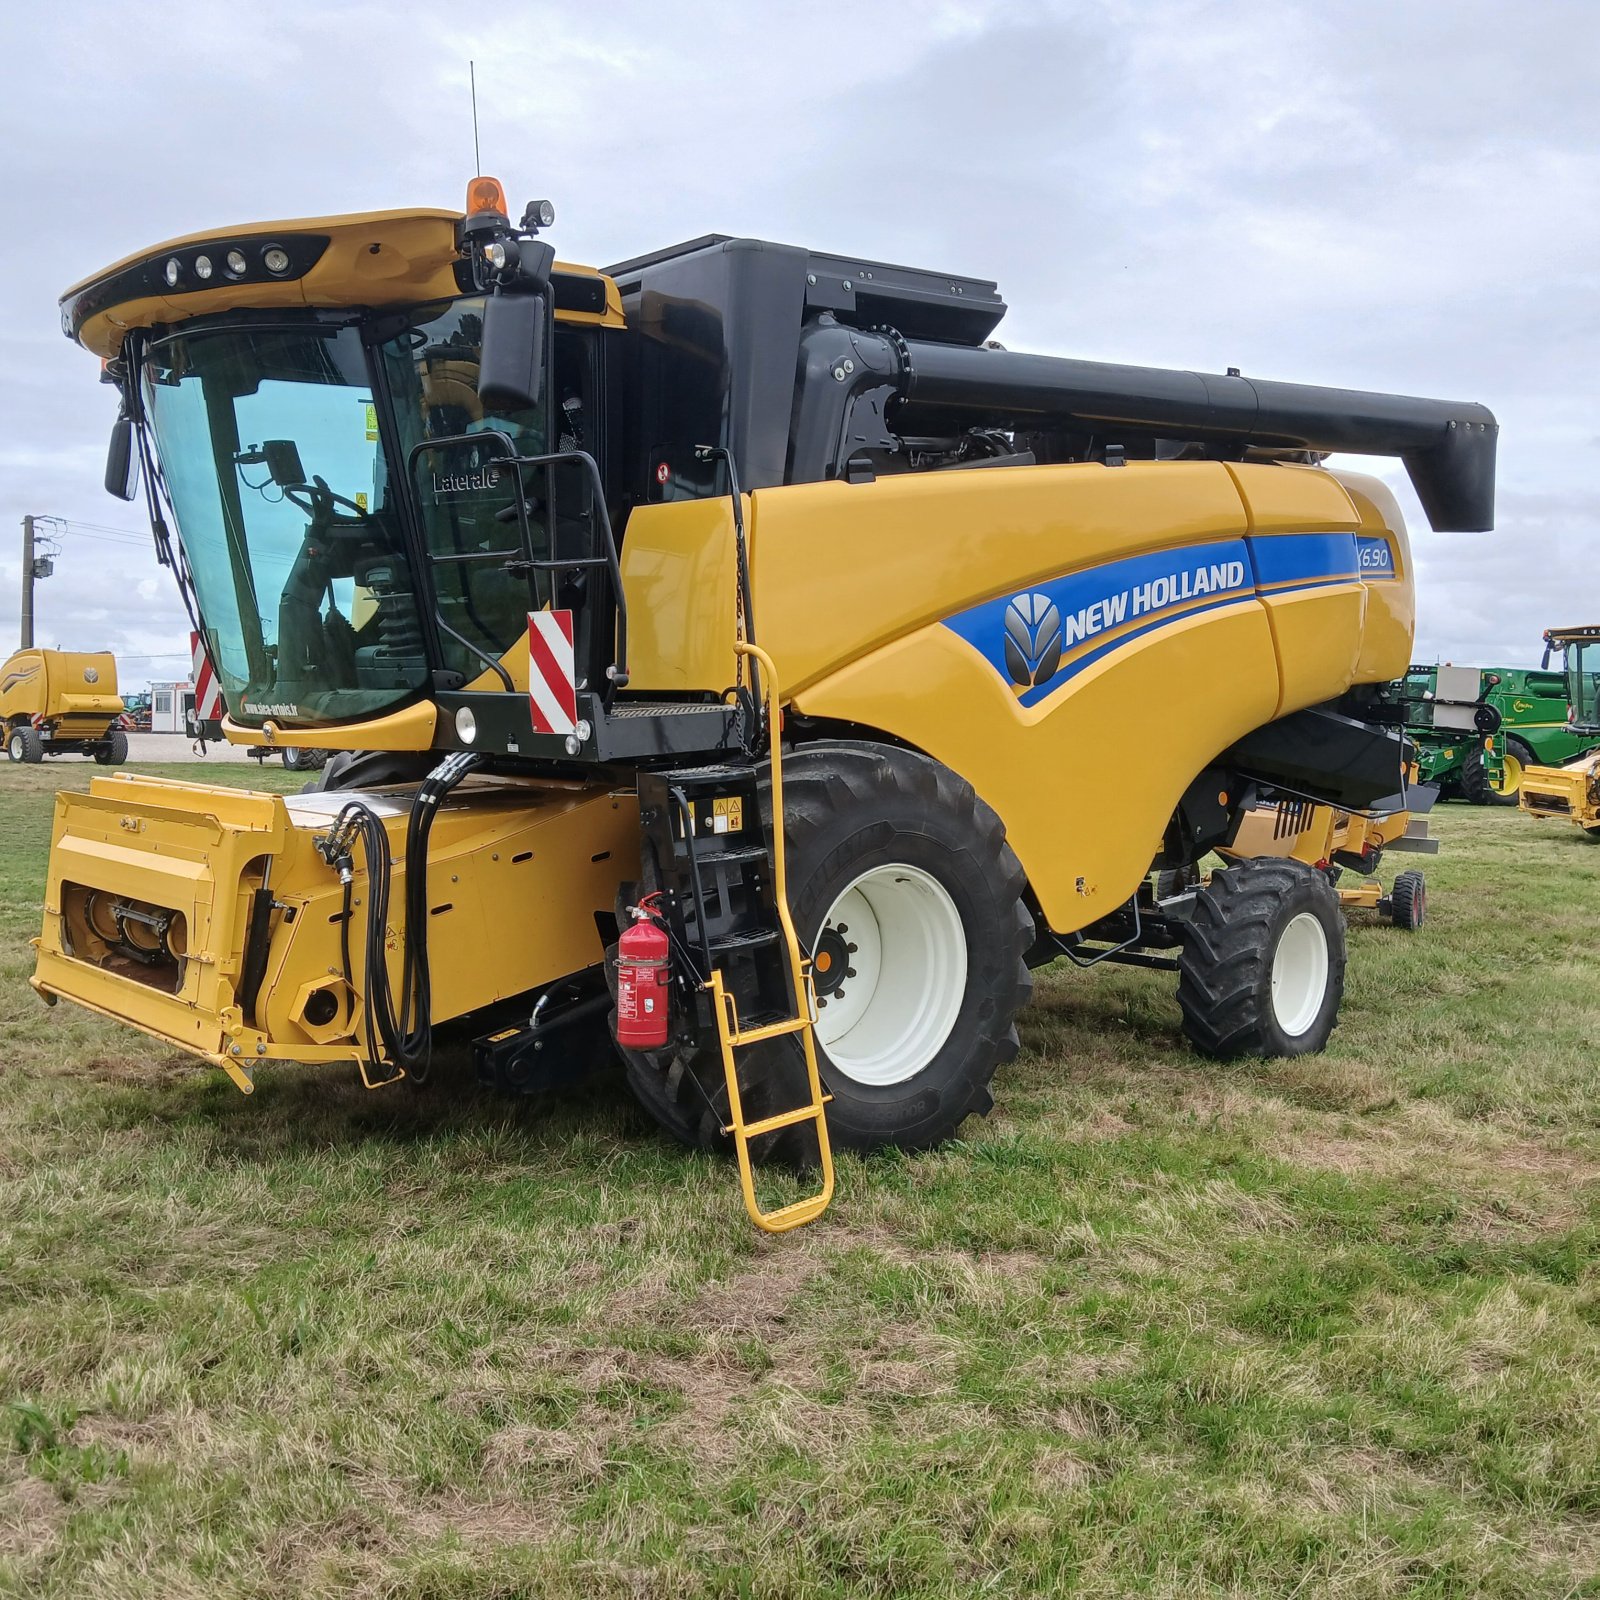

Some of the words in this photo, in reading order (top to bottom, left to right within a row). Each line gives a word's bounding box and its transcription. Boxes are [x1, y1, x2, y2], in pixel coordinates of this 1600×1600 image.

[433, 467, 498, 492] Laterale
[1066, 591, 1128, 646] NEW
[1132, 561, 1244, 616] HOLLAND
